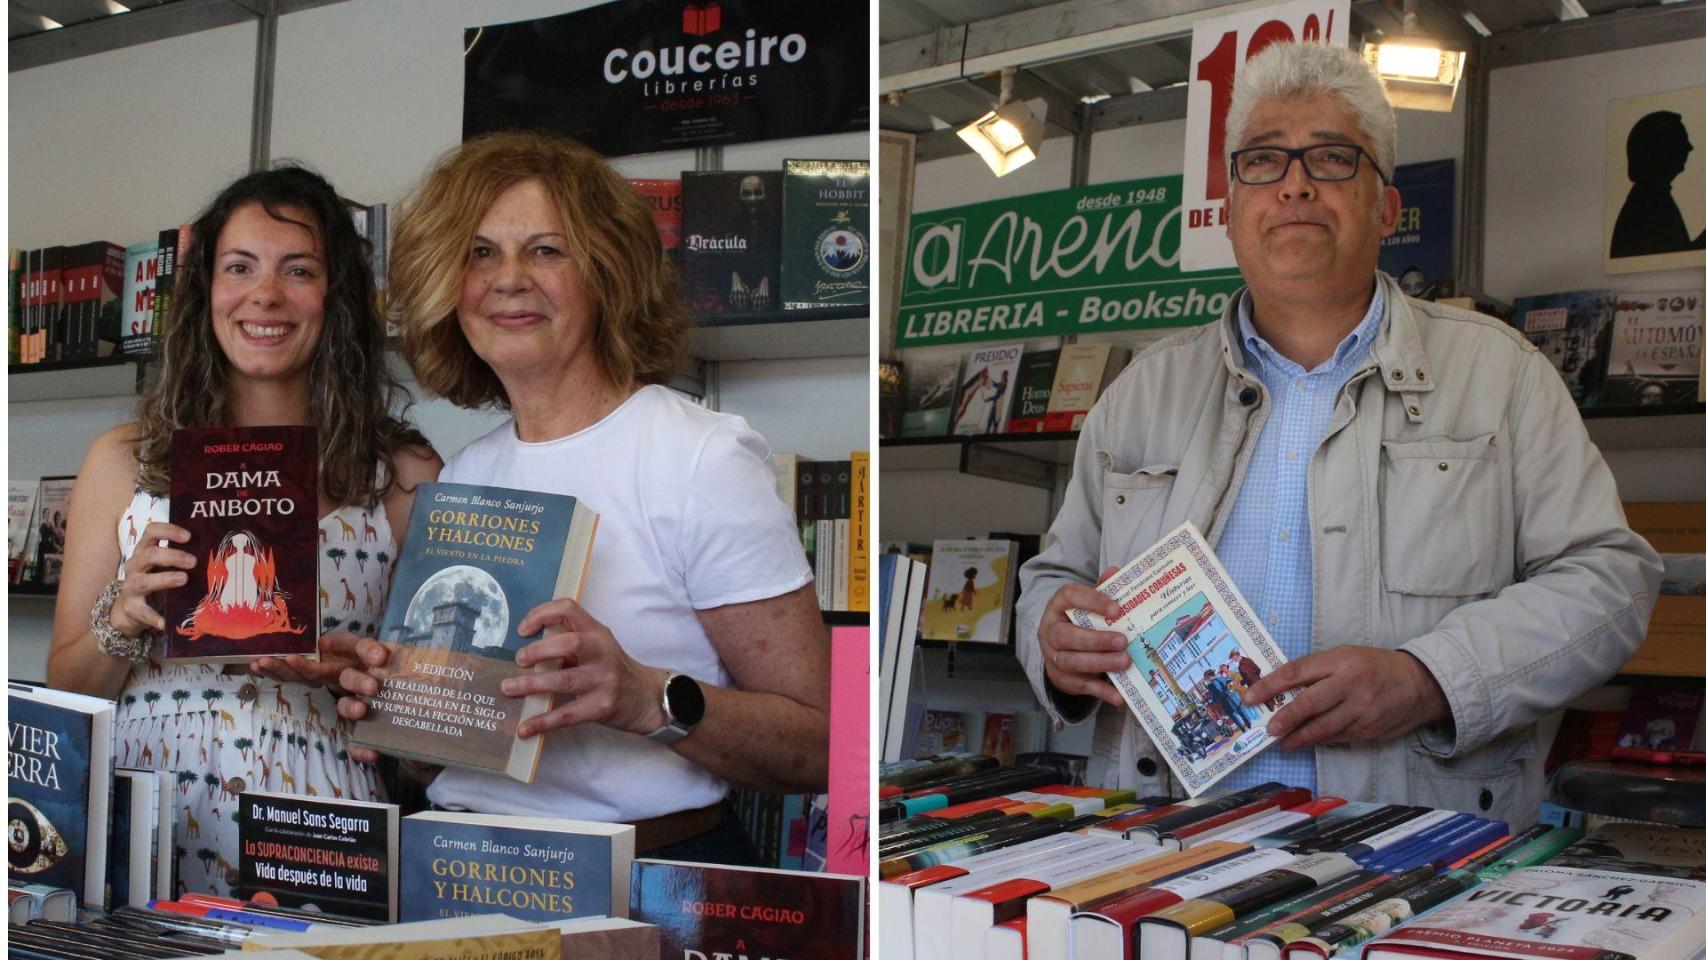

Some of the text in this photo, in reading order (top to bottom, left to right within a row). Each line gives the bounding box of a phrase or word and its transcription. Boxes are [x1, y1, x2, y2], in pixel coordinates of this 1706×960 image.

[604, 29, 807, 84] Couceiro
[644, 74, 758, 96] librerías
[661, 91, 740, 111] desde 1963
[819, 190, 865, 200] HOBBIT
[1076, 187, 1166, 211] desde 1948
[1189, 208, 1213, 228] DE
[904, 301, 1044, 338] LIBRERIA
[974, 348, 1019, 364] PRESIDIO
[1022, 386, 1050, 400] Homo
[1058, 380, 1093, 394] Sapiens
[1022, 402, 1045, 416] Deus
[204, 442, 283, 454] ROBER CAGIAO
[206, 471, 281, 489] DAMA
[190, 498, 295, 518] ANBOTO
[434, 493, 544, 515] Carmen Blanco Sanjurjo
[430, 509, 540, 534] GORRIONES
[427, 527, 535, 552] Y HALCONES
[436, 549, 465, 558] VIENTO
[494, 556, 525, 566] PIEDRA
[1148, 562, 1187, 594] CORUÑESAS
[423, 663, 475, 681] EDICIÓN
[383, 679, 496, 707] LA REALIDAD DE LO QUE
[371, 700, 497, 732] XV SUPERA LA FICCIÓN MÁS
[392, 692, 403, 702] EN
[405, 694, 443, 708] GALICIA
[444, 701, 459, 711] EN
[460, 703, 472, 714] EL
[474, 707, 506, 720] SIGLO
[391, 716, 464, 737] DESCABELLADA
[252, 804, 369, 834] Dr. Manuel Sans Segarra
[279, 829, 305, 837] colaboración
[245, 840, 379, 872] La SUPRACONCIENCIA existe
[433, 835, 574, 864] Carmen Blanco Sanjurjo
[255, 862, 368, 892] Vida después de la vida
[432, 858, 575, 890] GORRIONES
[434, 881, 573, 914] Y HALCONES
[1468, 889, 1673, 923] VICTORIA
[682, 900, 805, 924] ROBER CAGIAO
[735, 939, 746, 950] A
[1406, 929, 1462, 940] PREMIO
[1467, 936, 1532, 950] PLANETA
[1536, 945, 1575, 953] 2024
